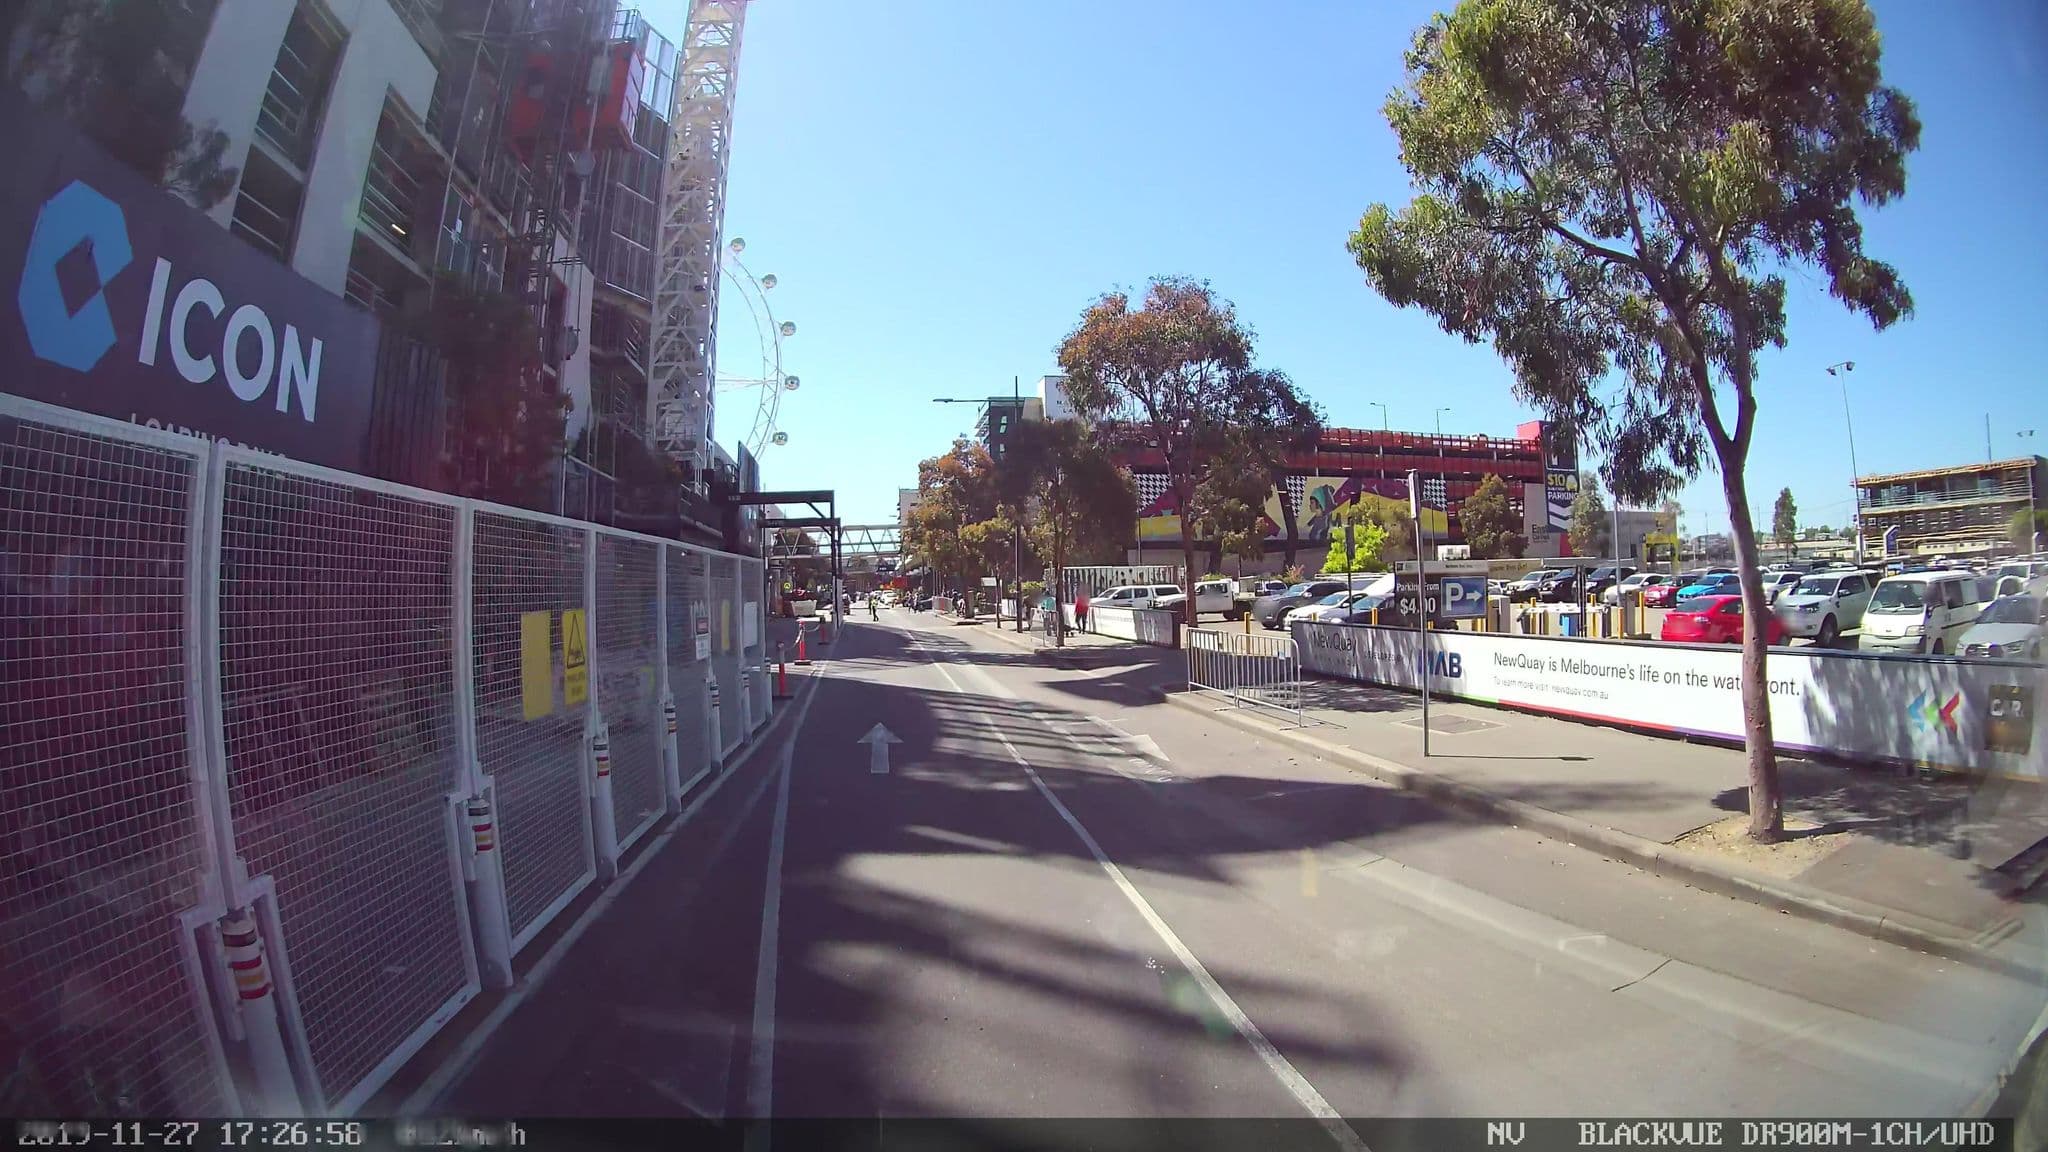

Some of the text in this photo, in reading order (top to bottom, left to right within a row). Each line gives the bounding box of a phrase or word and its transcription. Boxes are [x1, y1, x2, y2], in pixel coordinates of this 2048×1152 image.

[138, 256, 324, 424] ICON
[1445, 582, 1464, 611] P
[1494, 652, 1800, 697] NewQuay is Melbourne's life on the watont.
